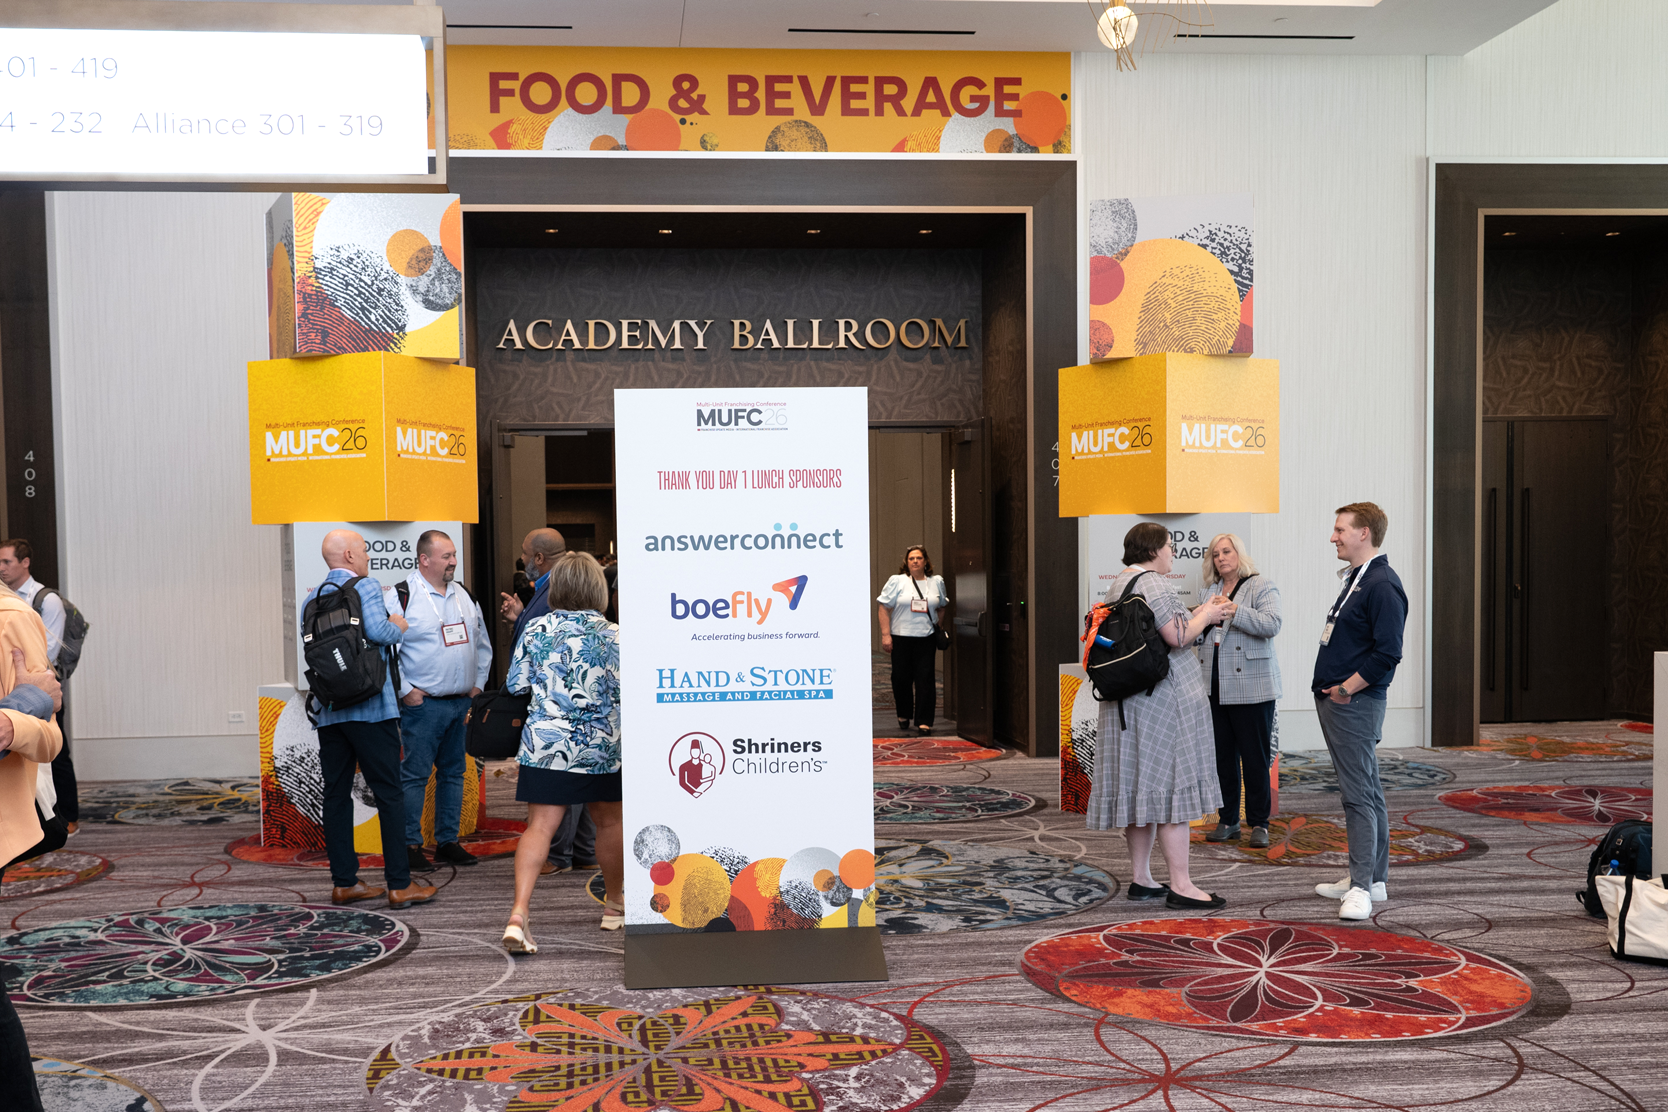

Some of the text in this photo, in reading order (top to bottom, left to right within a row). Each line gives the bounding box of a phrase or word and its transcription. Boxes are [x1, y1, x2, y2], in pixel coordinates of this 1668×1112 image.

[0, 56, 36, 78] 01
[71, 57, 118, 79] 419
[489, 71, 1022, 118] FOOD & BEVERAGE
[51, 111, 102, 134] 232
[132, 112, 246, 135] Alliance
[259, 114, 305, 136] 301
[339, 114, 383, 136] 319
[496, 318, 970, 350] ACADEMY BALLROOM
[330, 418, 365, 426] Conference
[1095, 419, 1122, 427] Franchising
[1122, 416, 1151, 424] Conference
[1208, 415, 1235, 424] Franchising
[24, 450, 36, 498] 408
[657, 468, 842, 490] THANK YOU DAY 1 LUNCH SPONSORS
[400, 540, 412, 552] &
[644, 524, 843, 552] answerconnect
[1188, 530, 1200, 542] &
[670, 590, 772, 625] boefly
[691, 631, 820, 642] Accelerating business forward.
[333, 648, 347, 671] THULE
[656, 668, 730, 688] HAND
[735, 672, 746, 682] &
[664, 693, 720, 701] MASSAGE
[757, 691, 798, 699] FACIAL
[804, 690, 826, 699] SPA
[732, 738, 822, 754] Shriners
